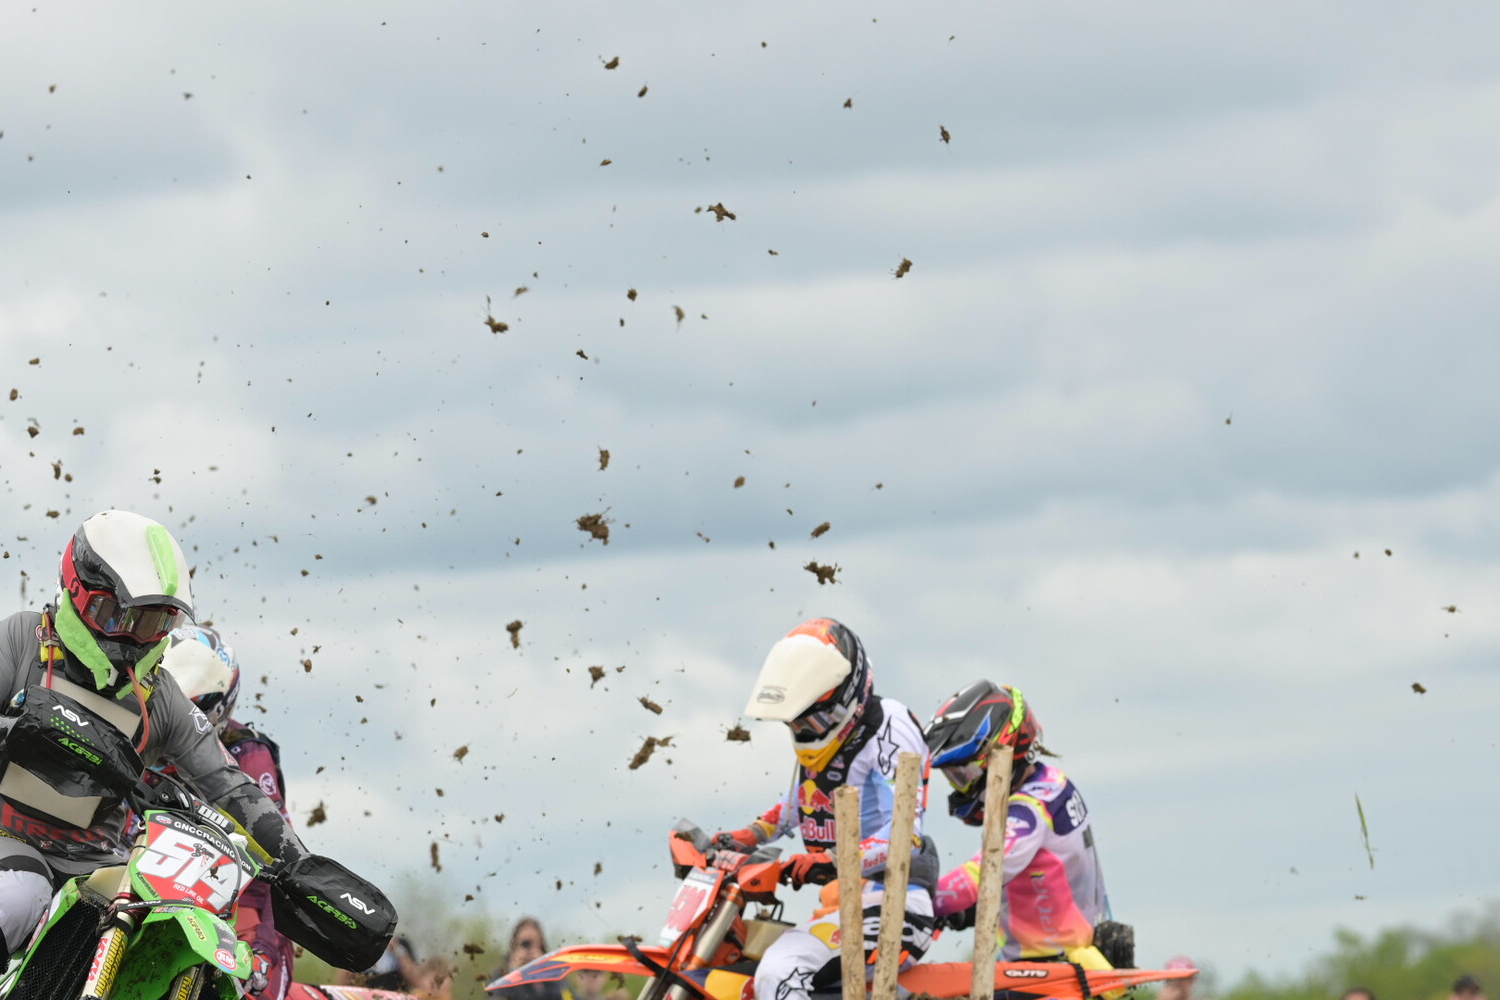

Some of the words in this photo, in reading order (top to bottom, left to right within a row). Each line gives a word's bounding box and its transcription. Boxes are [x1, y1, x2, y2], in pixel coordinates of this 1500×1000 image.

[53, 704, 89, 727] ASV
[174, 821, 251, 871] GNCCRACING.OM
[135, 826, 253, 912] 514
[173, 883, 186, 892] RED
[340, 892, 376, 915] ASV
